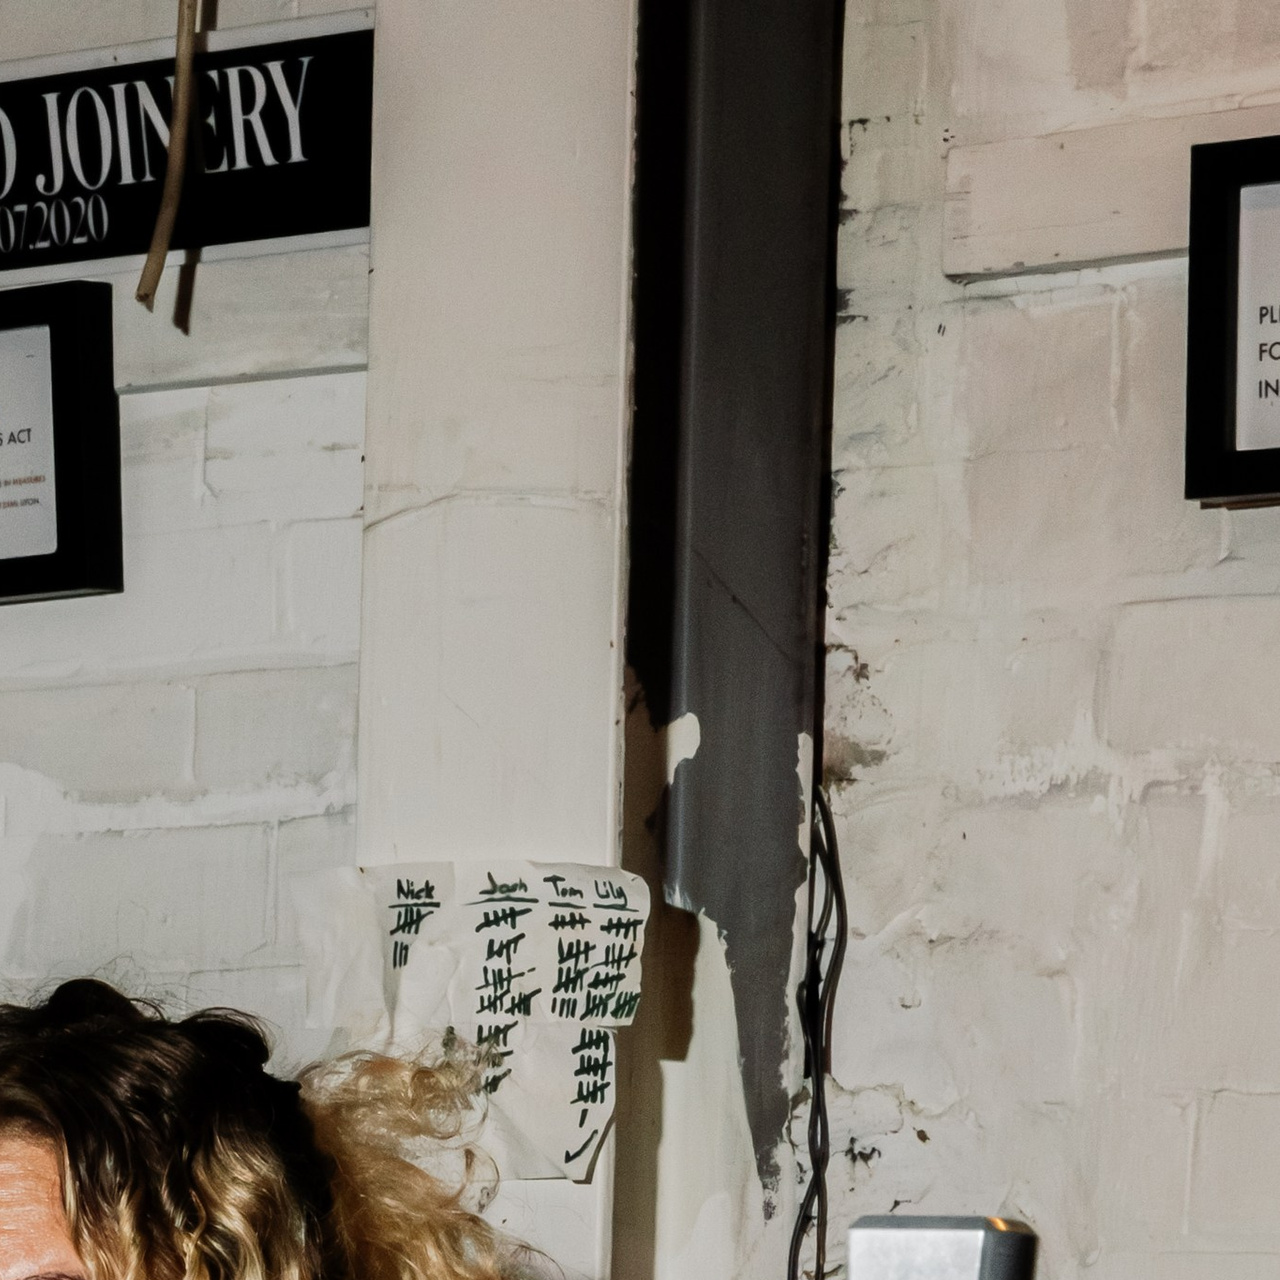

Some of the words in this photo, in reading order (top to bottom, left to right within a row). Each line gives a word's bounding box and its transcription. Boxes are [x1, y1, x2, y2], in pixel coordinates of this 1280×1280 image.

[35, 56, 315, 197] JOINERY
[1259, 306, 1280, 325] PL
[7, 428, 32, 445] ACT
[396, 878, 435, 901] Nick
[543, 875, 584, 898] Tom
[594, 879, 628, 908] Lily
